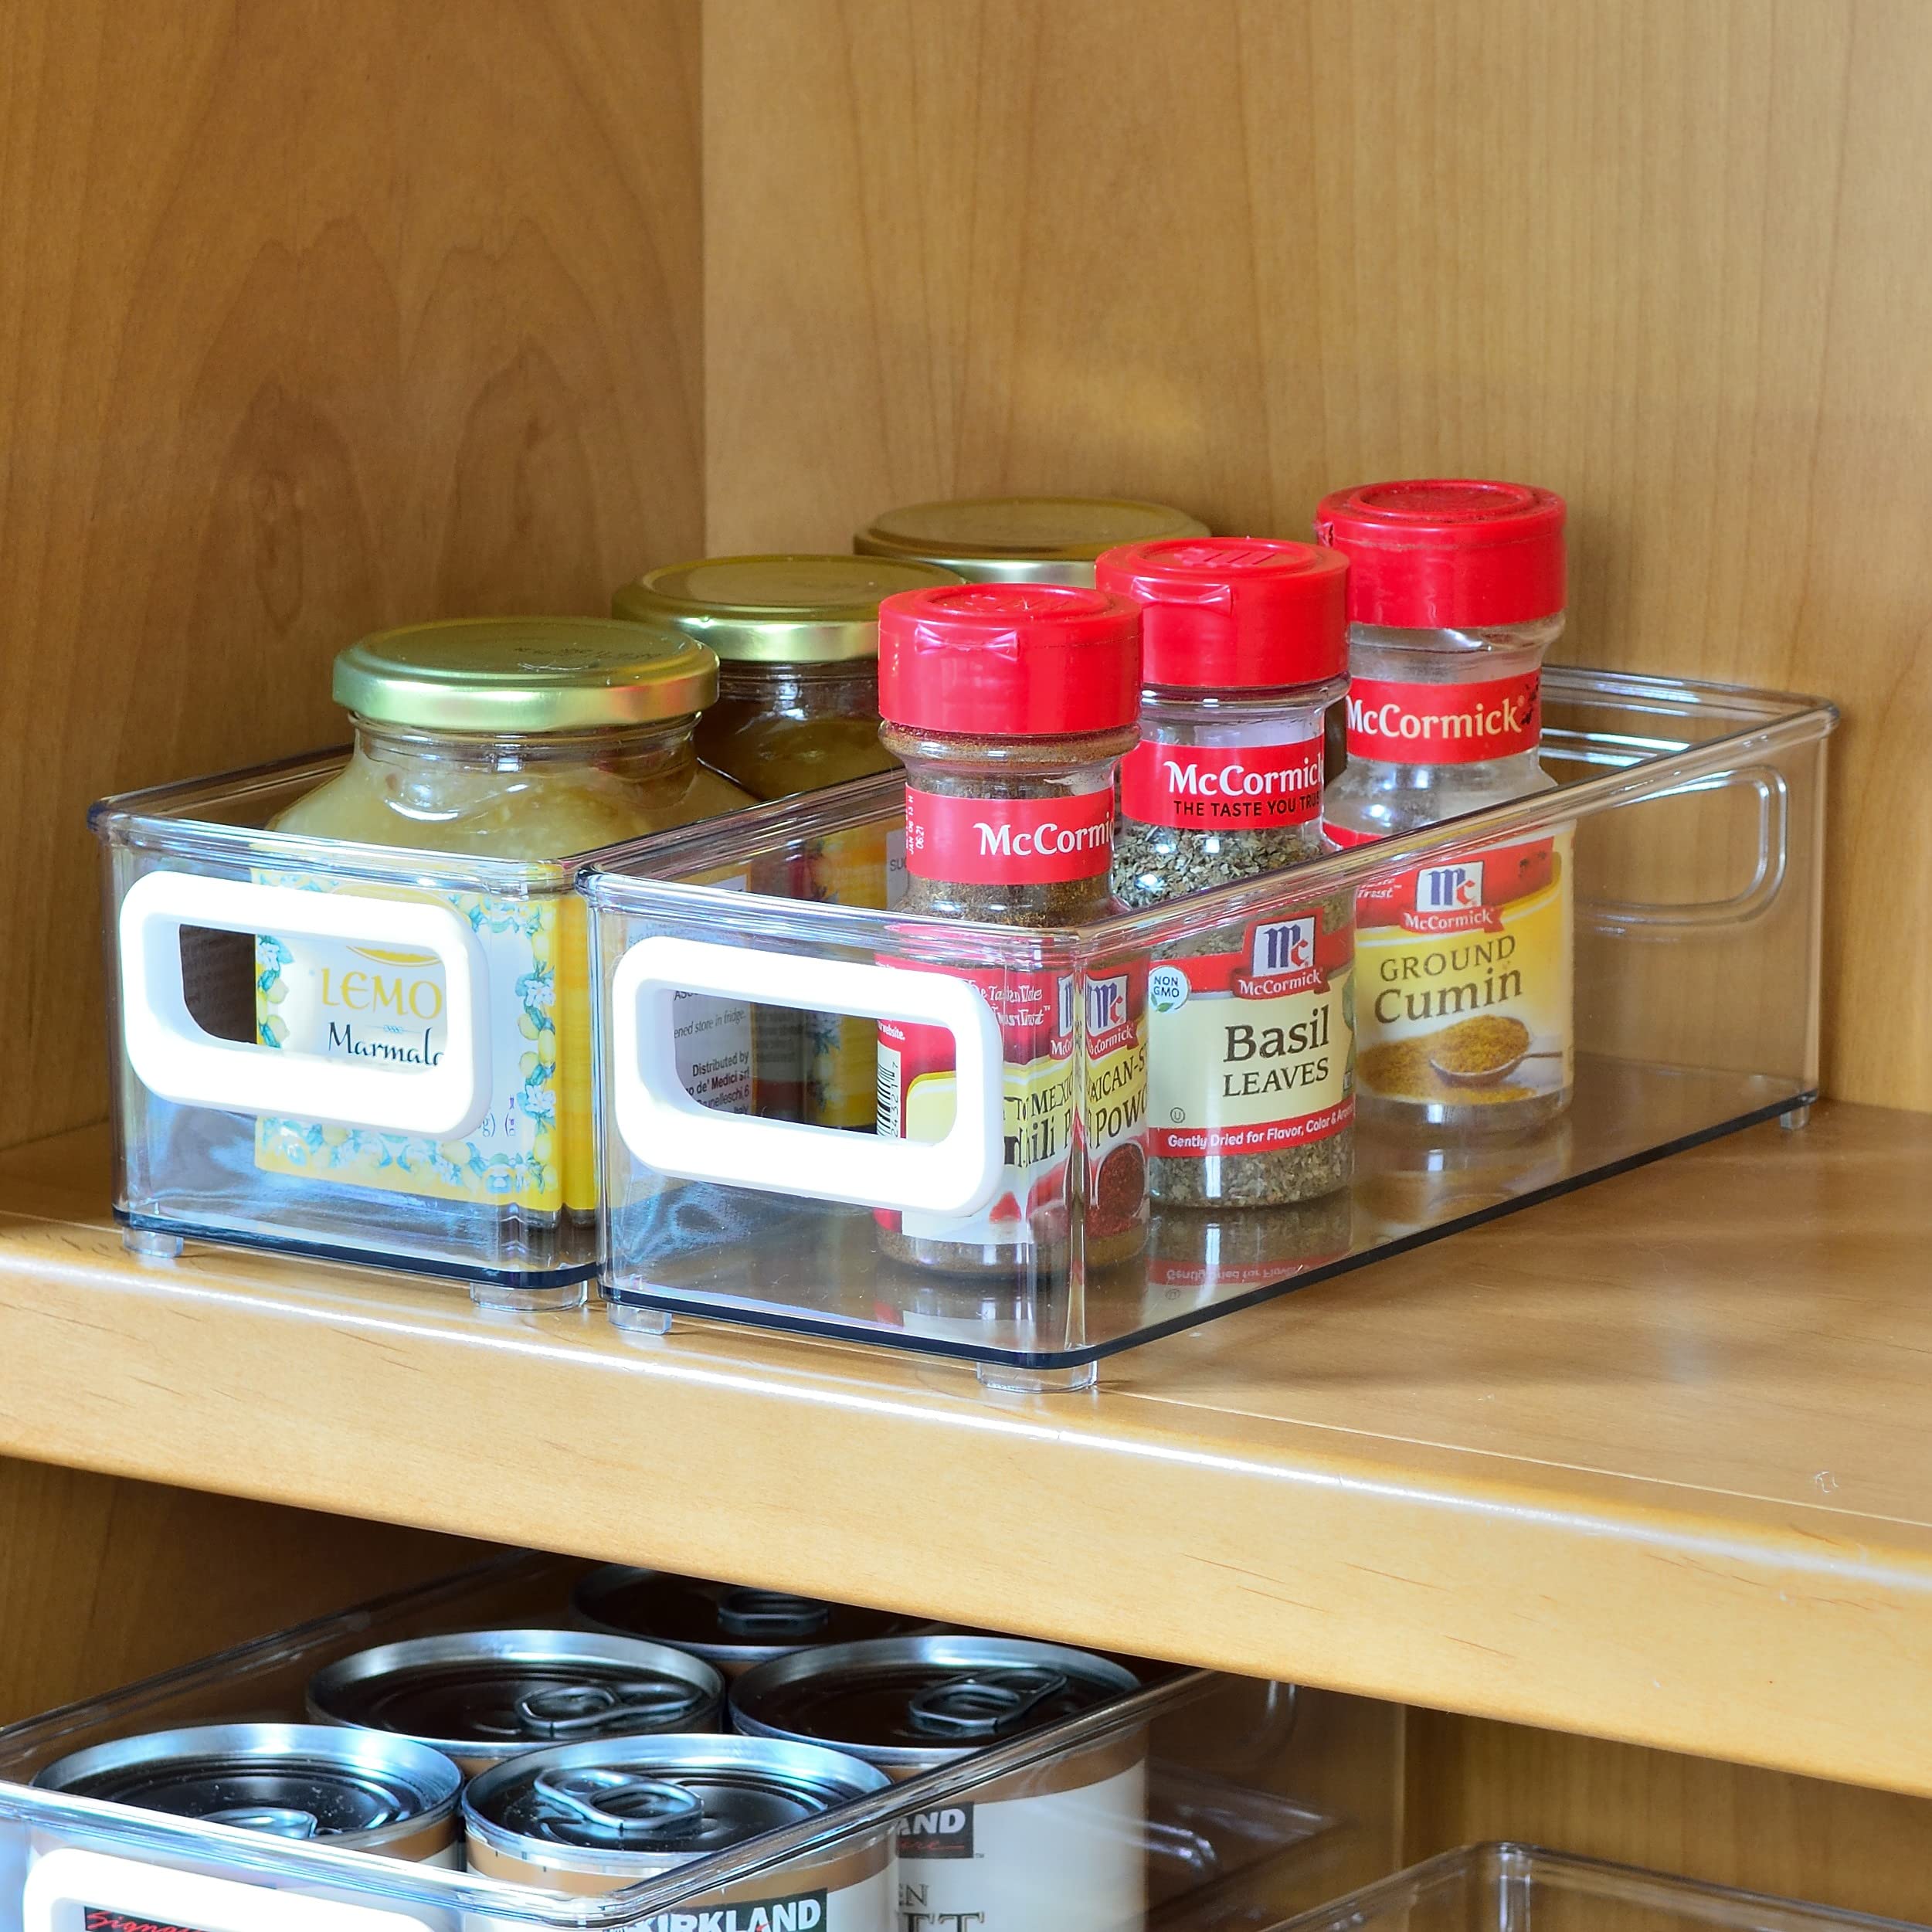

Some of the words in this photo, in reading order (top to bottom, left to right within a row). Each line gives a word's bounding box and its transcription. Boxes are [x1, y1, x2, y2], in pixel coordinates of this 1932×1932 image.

[1346, 695, 1523, 739] McCormick
[1173, 800, 1205, 817] THE
[1210, 801, 1262, 817] TASTE
[1267, 799, 1296, 815] YOU
[890, 859, 906, 871] SU
[1403, 909, 1494, 931] McCormick
[1380, 935, 1516, 983] GROUND
[321, 967, 443, 1020] LEMO
[1153, 986, 1180, 998] GMO
[1154, 976, 1180, 986] NON
[1238, 968, 1323, 997] McCormick
[1374, 966, 1523, 1024] Cumin
[695, 1018, 714, 1034] store
[715, 1015, 722, 1027] in
[1223, 1004, 1330, 1063] Basil
[692, 1051, 738, 1077] Distributed
[739, 1050, 749, 1064] by
[1222, 1057, 1329, 1097] LEAVES
[711, 1071, 738, 1091] Medici
[1168, 1134, 1207, 1149] Gently
[1210, 1133, 1243, 1146] Dried
[1247, 1130, 1264, 1143] for
[1267, 1125, 1304, 1142] Flavor,
[1306, 1117, 1330, 1133] Color
